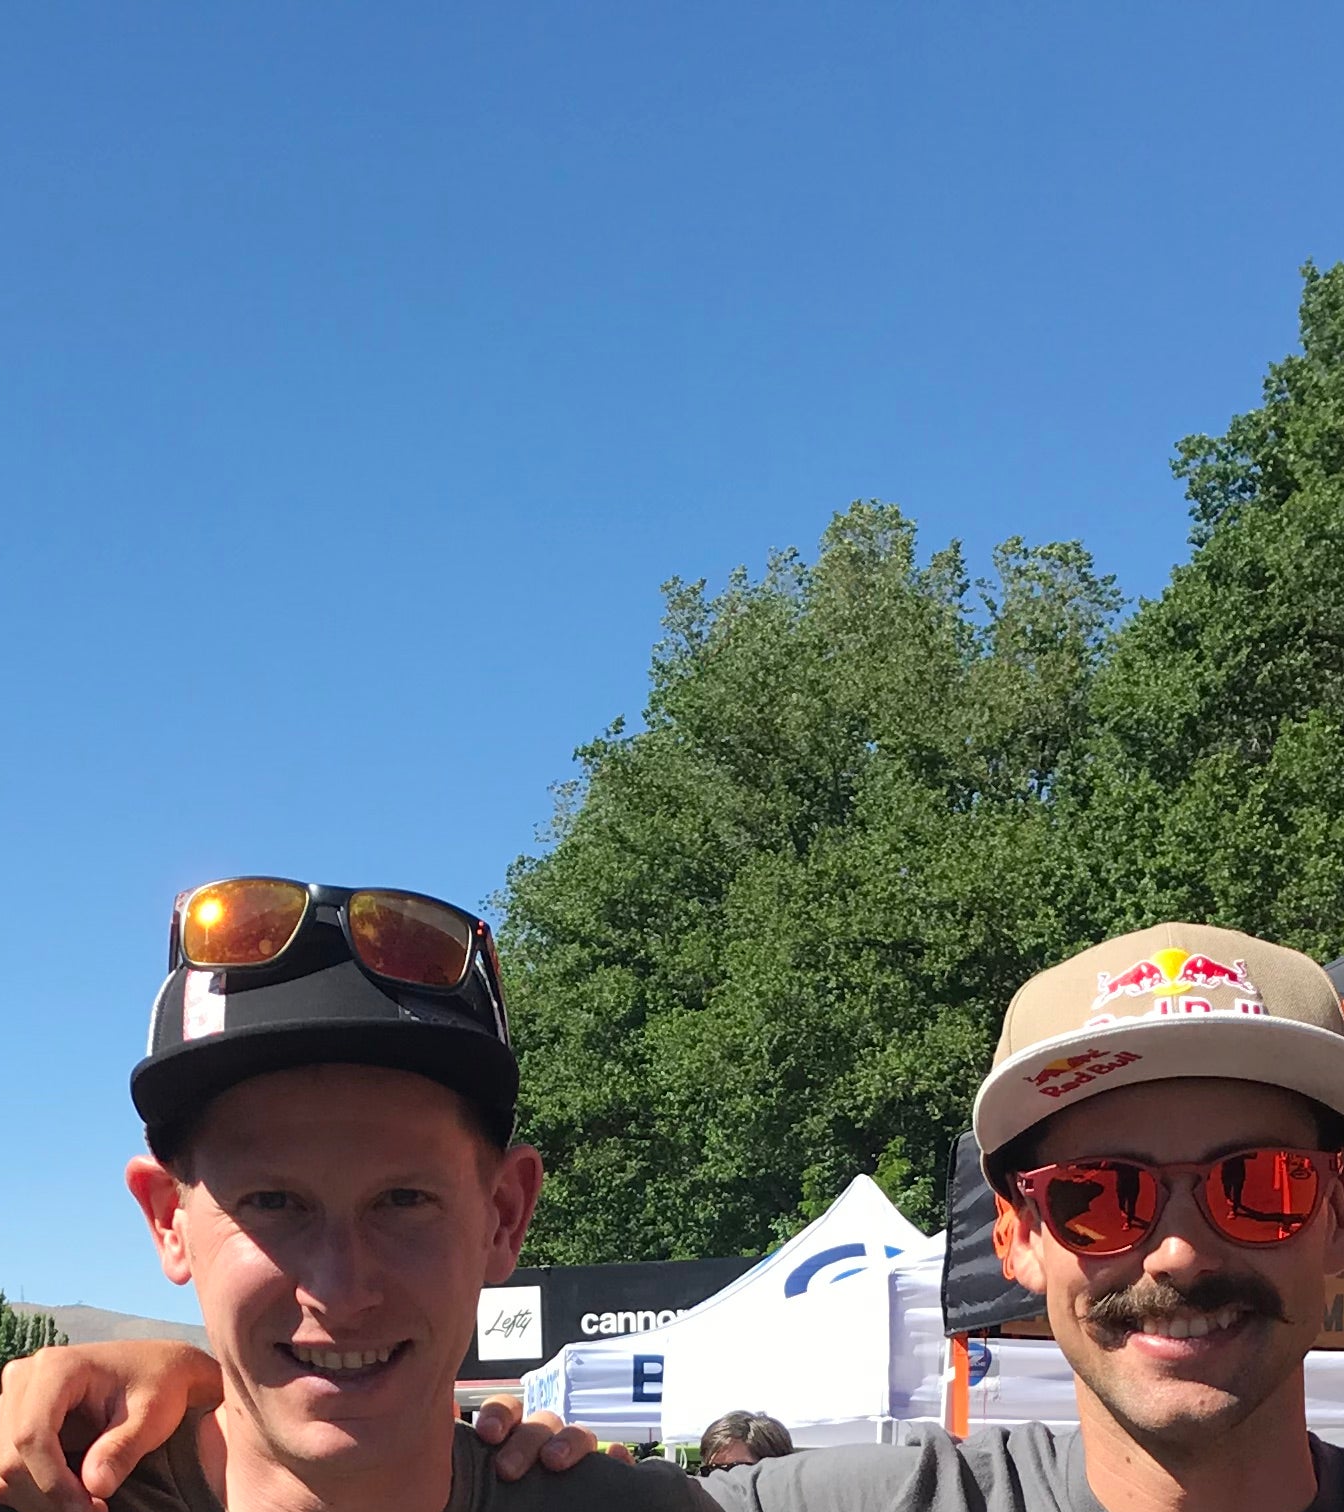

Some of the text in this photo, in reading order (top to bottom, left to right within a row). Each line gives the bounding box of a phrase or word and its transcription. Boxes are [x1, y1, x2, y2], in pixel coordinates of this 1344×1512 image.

[1039, 1051, 1144, 1098] Red Bull
[484, 1309, 532, 1338] Lefty
[581, 1309, 690, 1334] canno
